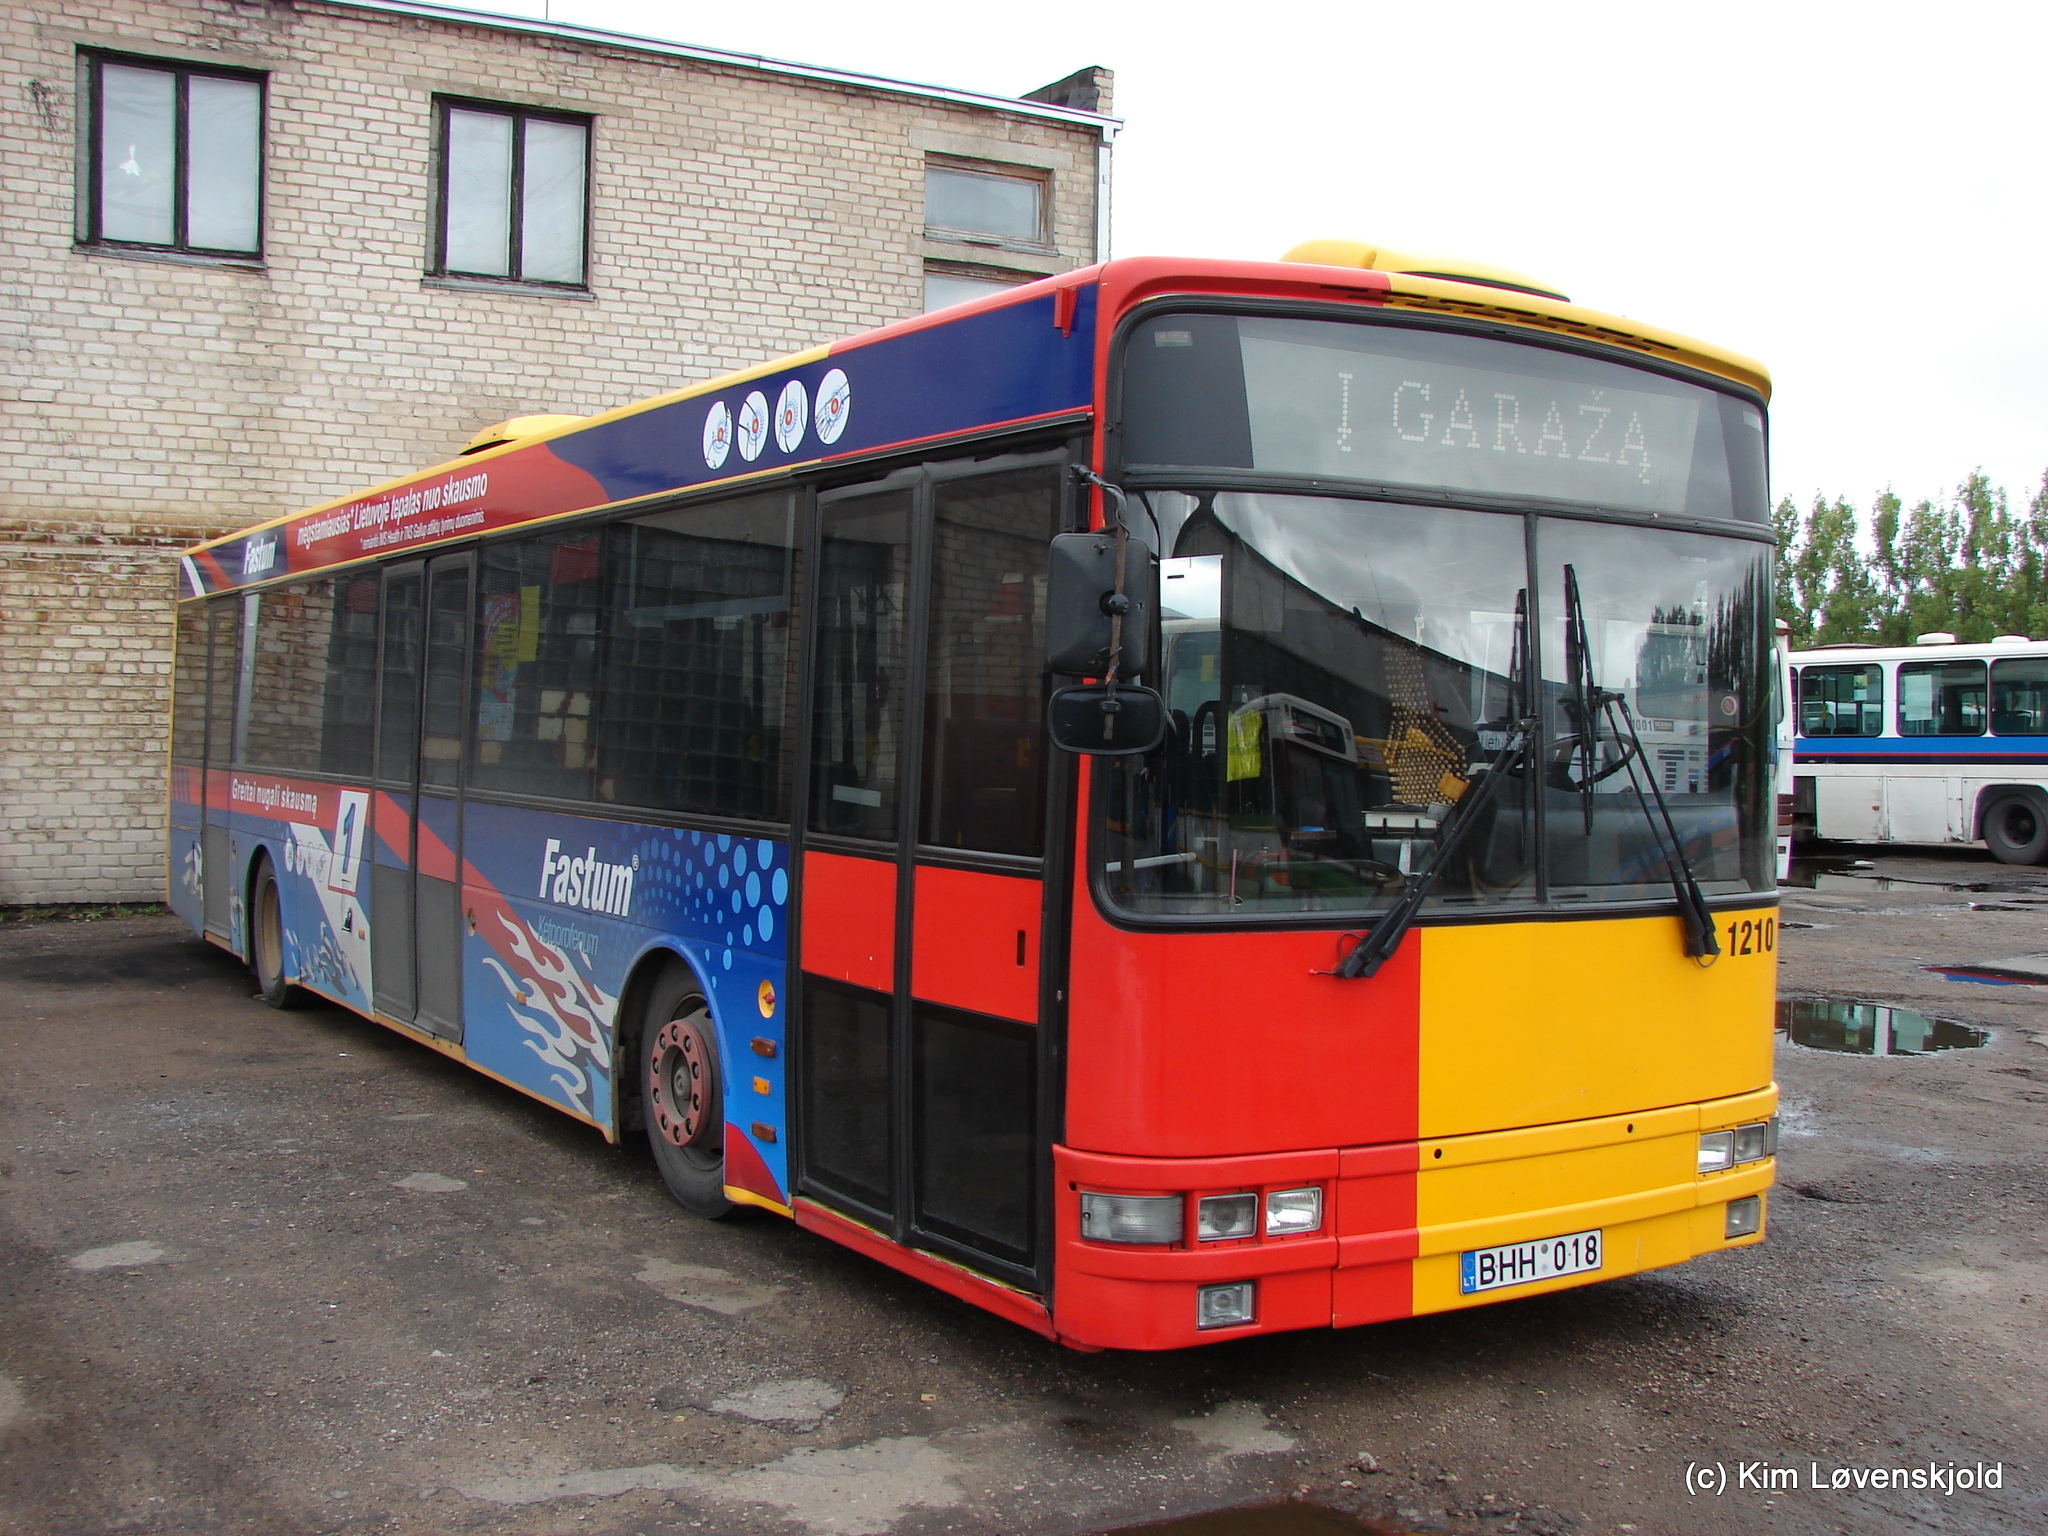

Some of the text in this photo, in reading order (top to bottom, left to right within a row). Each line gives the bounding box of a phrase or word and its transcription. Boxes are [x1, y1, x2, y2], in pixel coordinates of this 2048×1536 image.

[1392, 380, 1651, 485] GARAŽĄ
[354, 496, 390, 530] Lietuvoje
[390, 488, 422, 526] tepalas
[422, 486, 441, 512] nuo
[442, 473, 488, 507] skausmo
[232, 778, 318, 820] Greitai nugali skausmą
[537, 914, 599, 957] Ketoprofenum
[1727, 916, 1774, 957] 1210
[1463, 1276, 1475, 1287] LT
[1479, 1235, 1597, 1286] BHH 018
